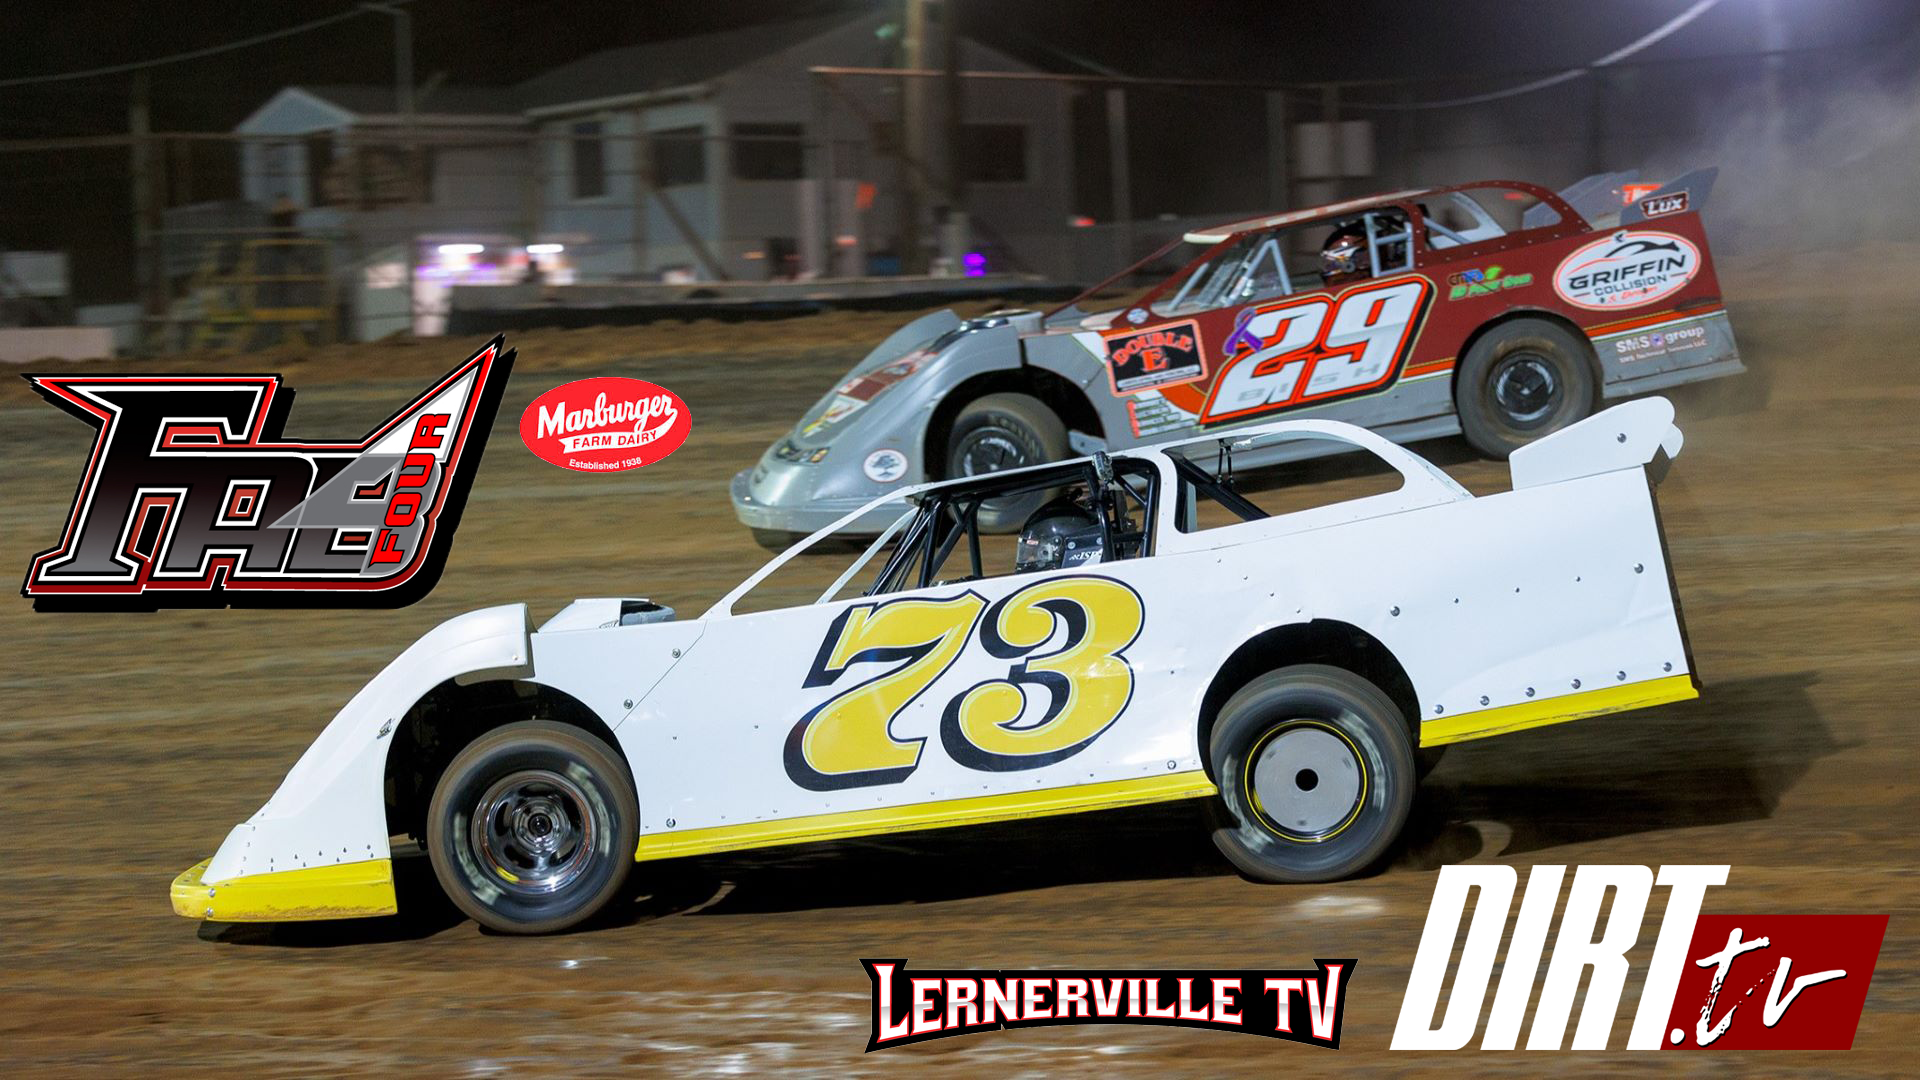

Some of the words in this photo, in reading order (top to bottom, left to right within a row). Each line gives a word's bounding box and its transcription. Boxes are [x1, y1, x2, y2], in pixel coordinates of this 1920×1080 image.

[1568, 254, 1686, 290] GRIFFIN
[1593, 273, 1668, 296] COLLISION
[1112, 331, 1194, 367] DOUBLE
[1203, 278, 1430, 425] 29
[1615, 335, 1650, 353] SMS
[1664, 326, 1705, 344] group
[1140, 347, 1169, 372] E
[1237, 363, 1381, 402] BISH
[783, 572, 1146, 792] 73
